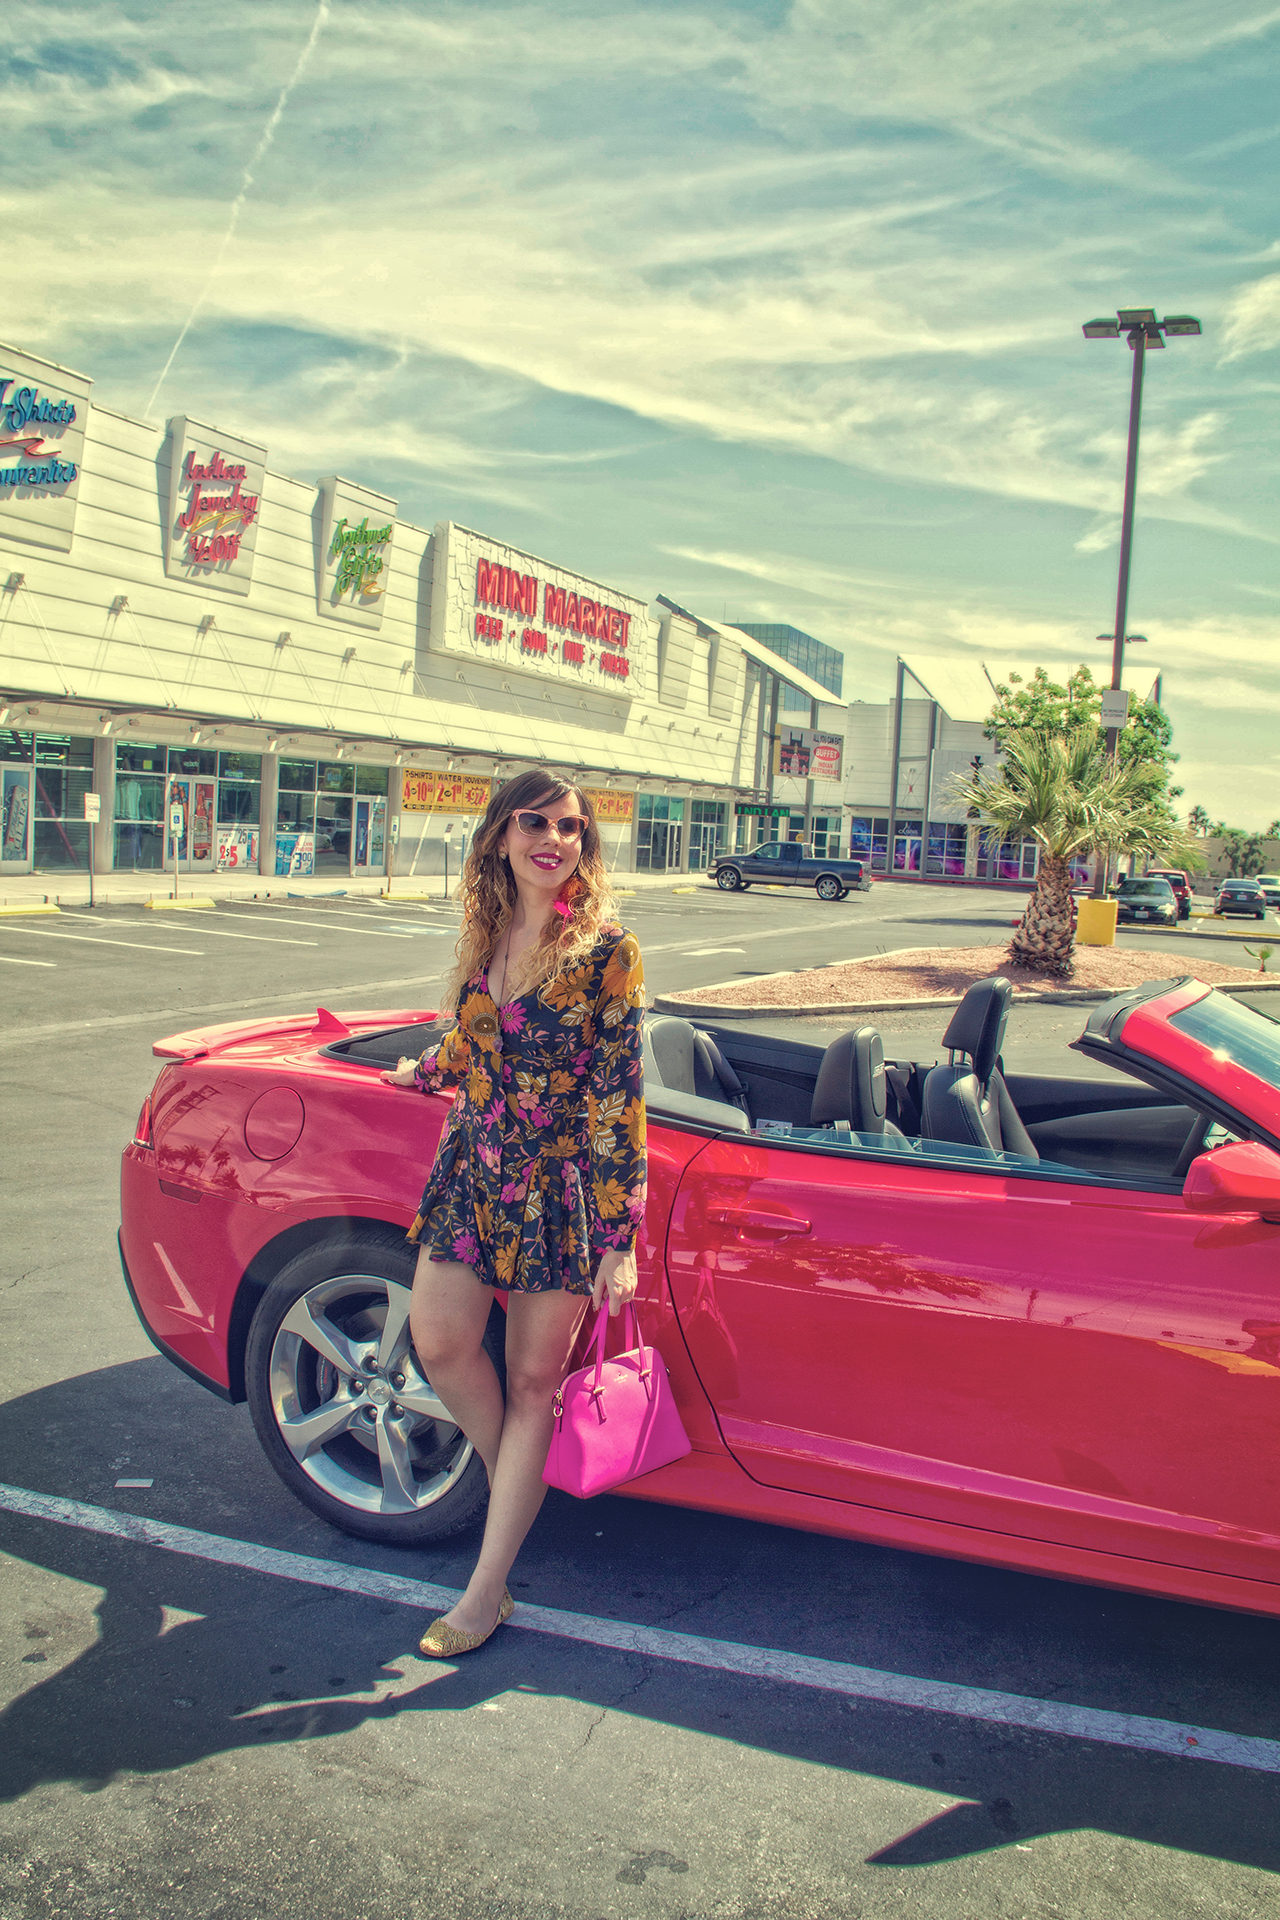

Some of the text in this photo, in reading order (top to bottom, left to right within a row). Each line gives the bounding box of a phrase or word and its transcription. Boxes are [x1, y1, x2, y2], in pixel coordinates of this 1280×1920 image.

[0, 459, 77, 487] uvenirs
[186, 450, 247, 480] Indian
[180, 483, 258, 528] Jewelry
[336, 545, 383, 596] Gifts
[477, 557, 631, 648] MINI MARKET
[475, 613, 629, 677] BEER SODA WINE SNACKS
[815, 747, 837, 759] BUFFET
[405, 770, 491, 785] T-SHIRTS WATER SOUVENIRS
[811, 767, 839, 776] RESTAURANT
[437, 782, 444, 802] 2
